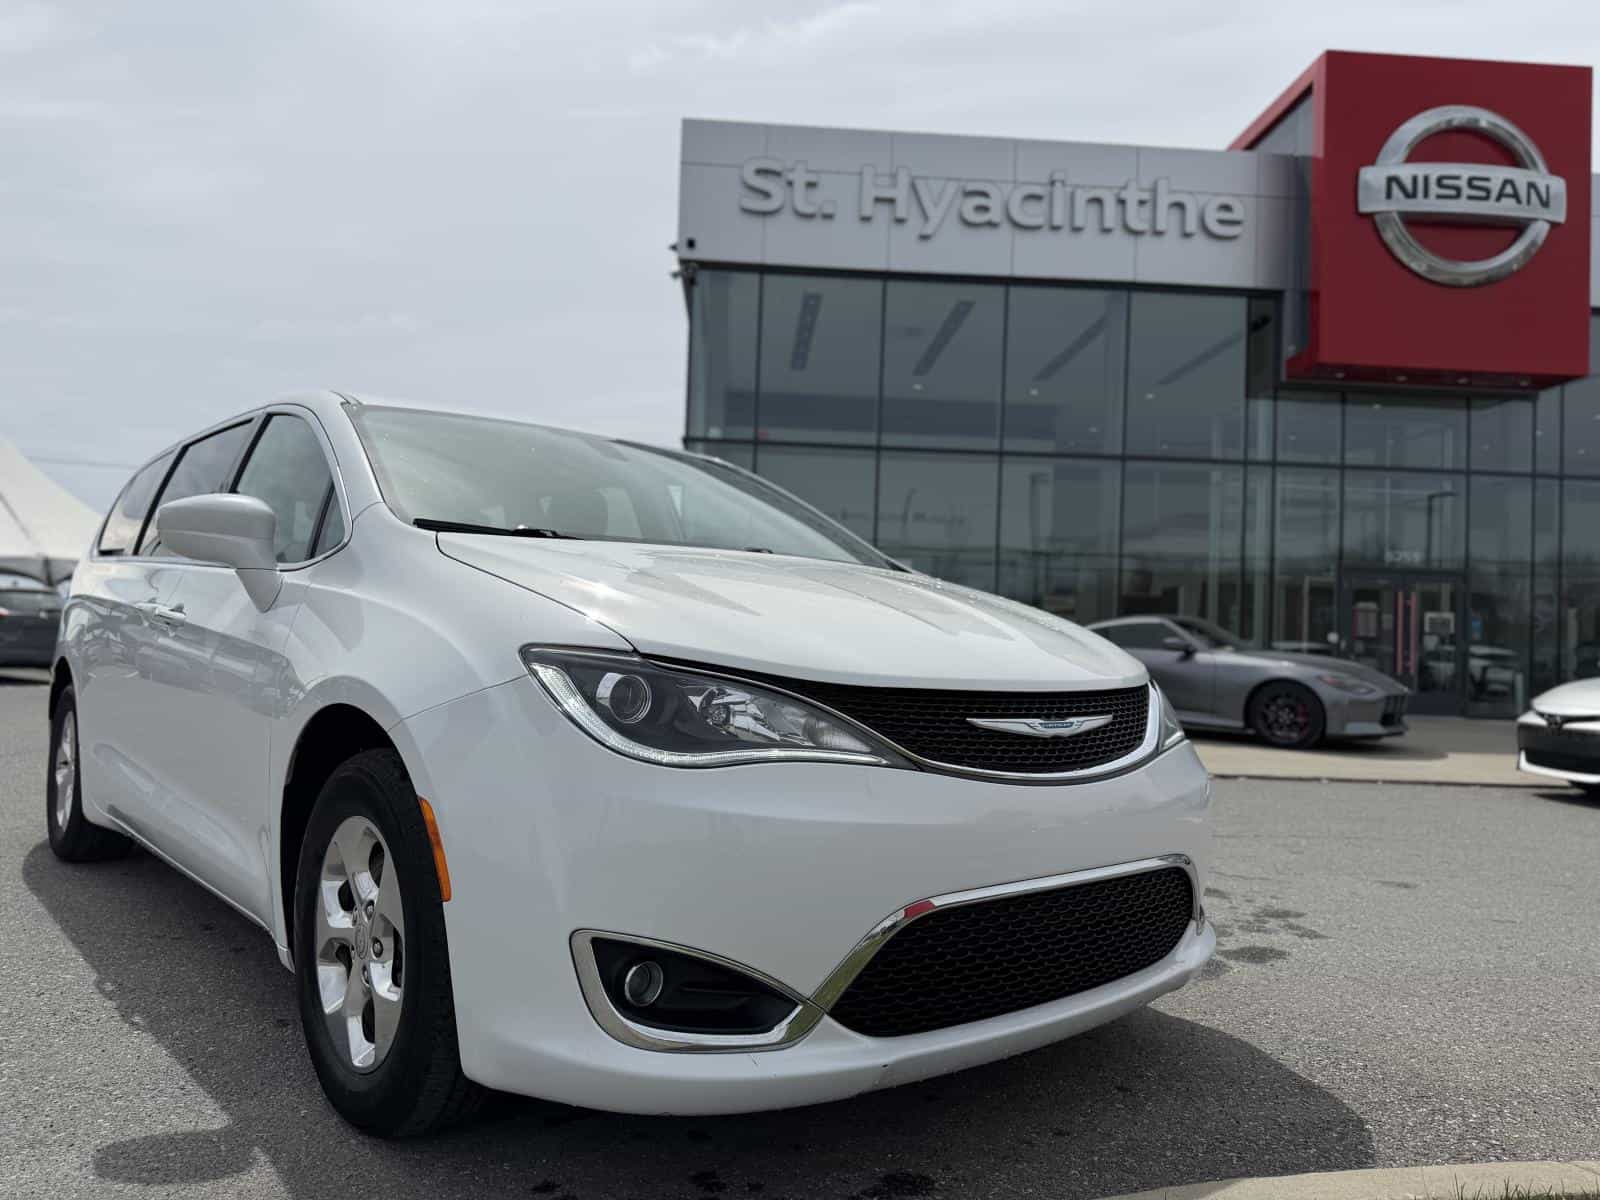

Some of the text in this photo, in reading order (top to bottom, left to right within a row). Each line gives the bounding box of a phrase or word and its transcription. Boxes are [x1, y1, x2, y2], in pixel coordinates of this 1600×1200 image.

[739, 156, 1245, 241] St. Hyacinthe
[1385, 174, 1550, 209] NISSAN
